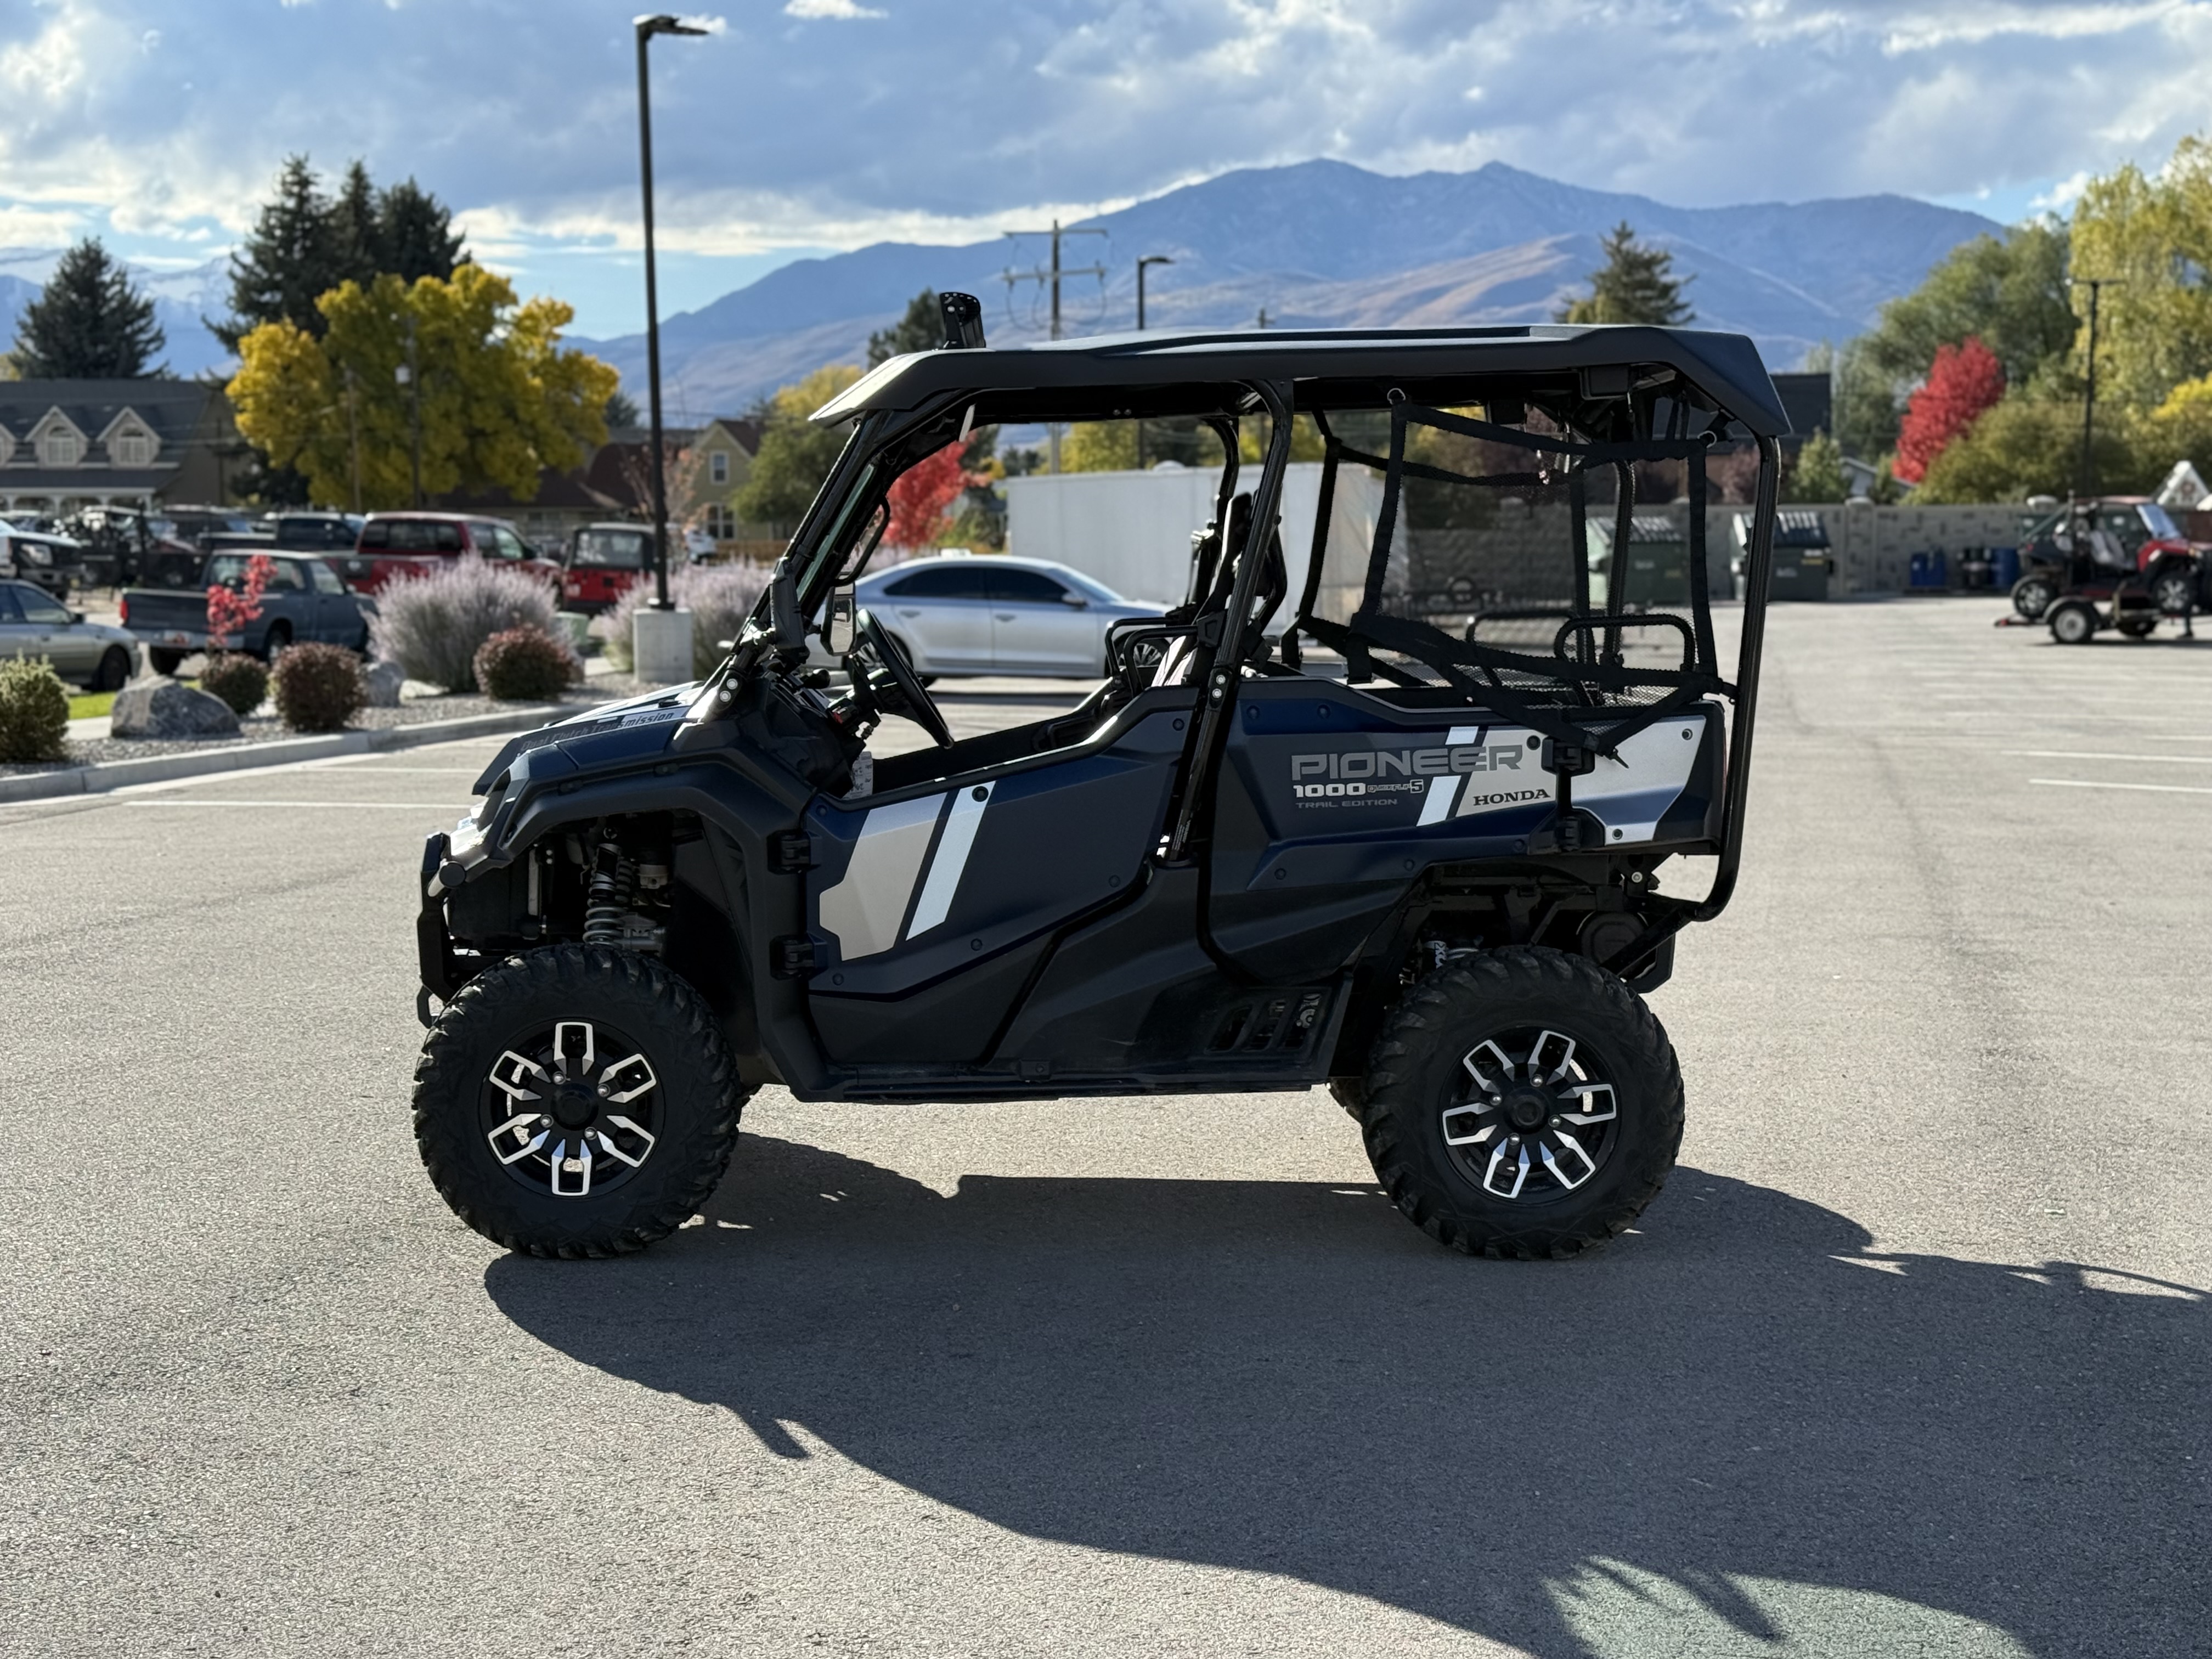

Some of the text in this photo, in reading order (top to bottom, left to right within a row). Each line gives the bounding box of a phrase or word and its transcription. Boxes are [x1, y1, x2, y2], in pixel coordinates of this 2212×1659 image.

[591, 713, 674, 732] Transmission
[1291, 745, 1523, 781] PIONEER
[1293, 783, 1366, 798] 1000
[1474, 789, 1550, 805] HONDA
[1342, 799, 1397, 808] EDITION
